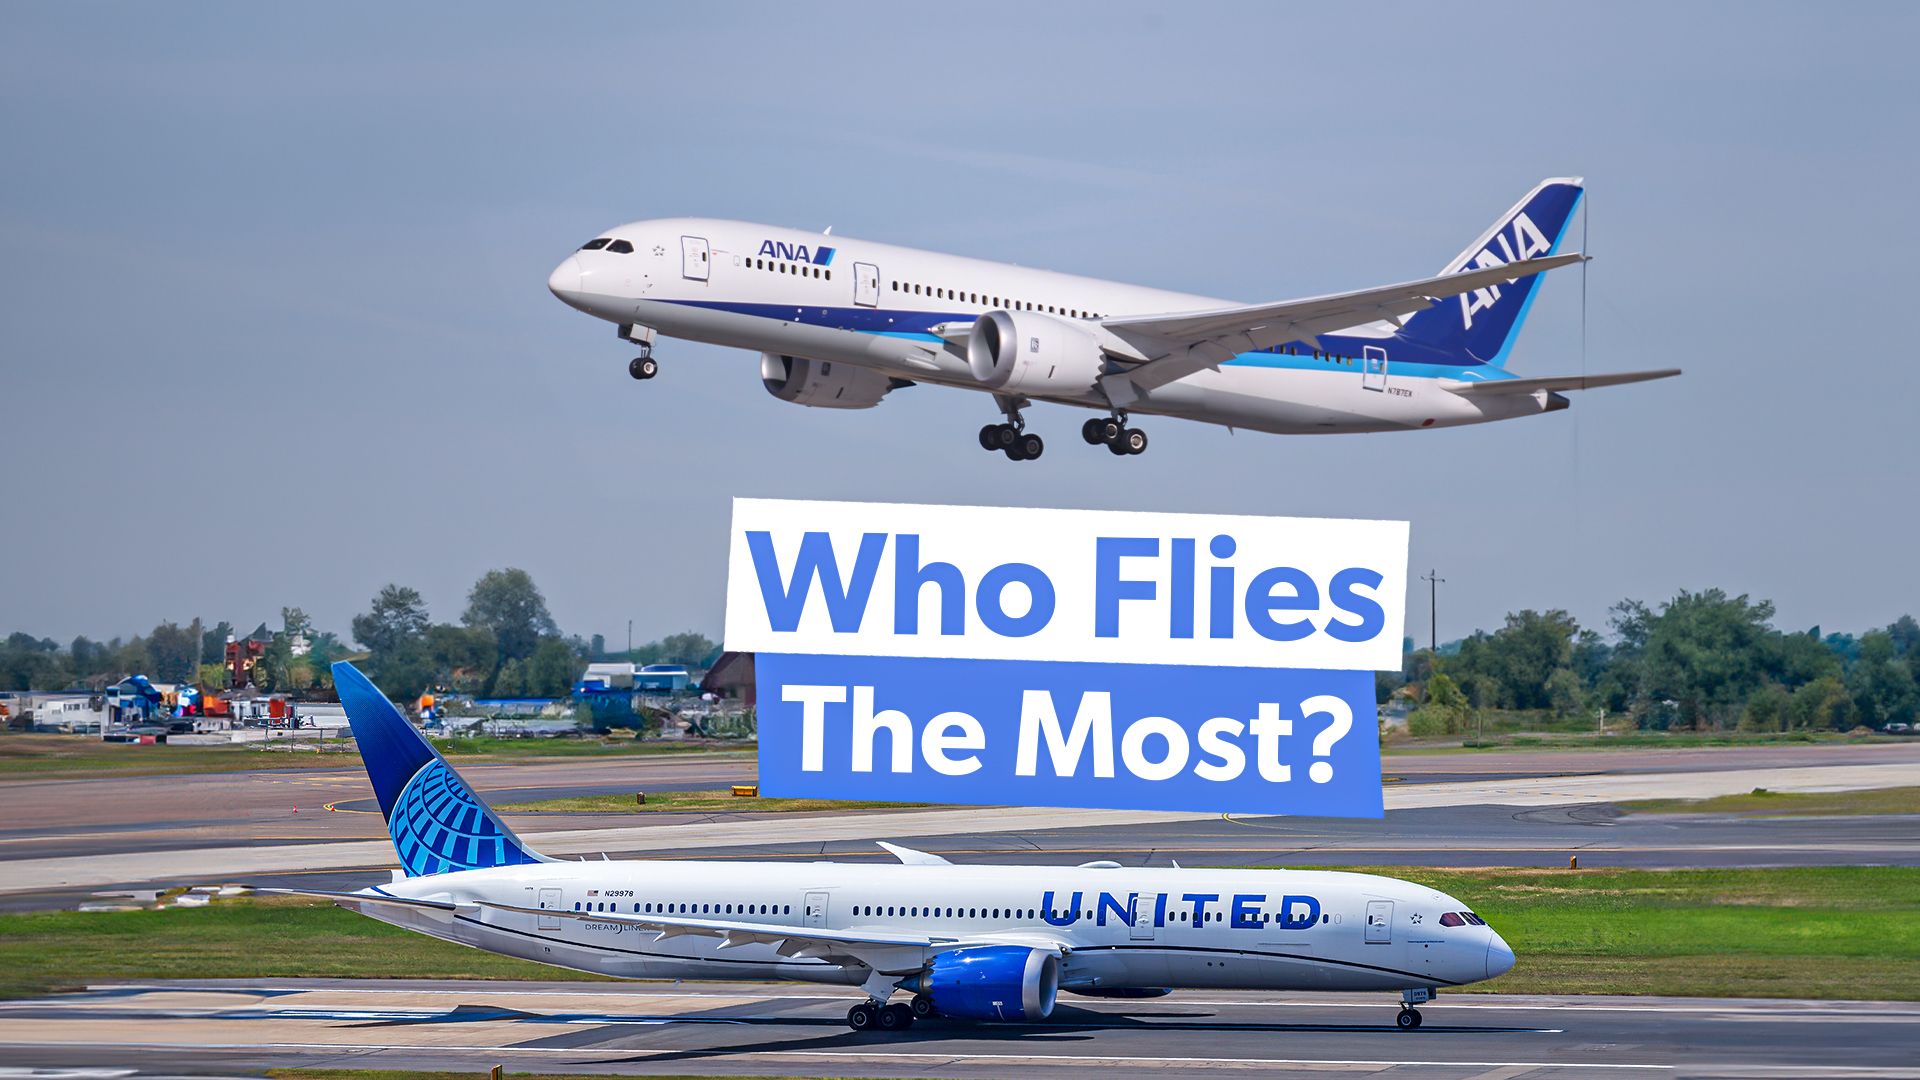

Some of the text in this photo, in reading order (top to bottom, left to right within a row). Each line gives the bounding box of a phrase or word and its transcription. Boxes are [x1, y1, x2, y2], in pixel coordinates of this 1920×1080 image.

[758, 240, 811, 264] ANA
[1459, 211, 1551, 331] ANA
[1041, 891, 1322, 930] UNITED
